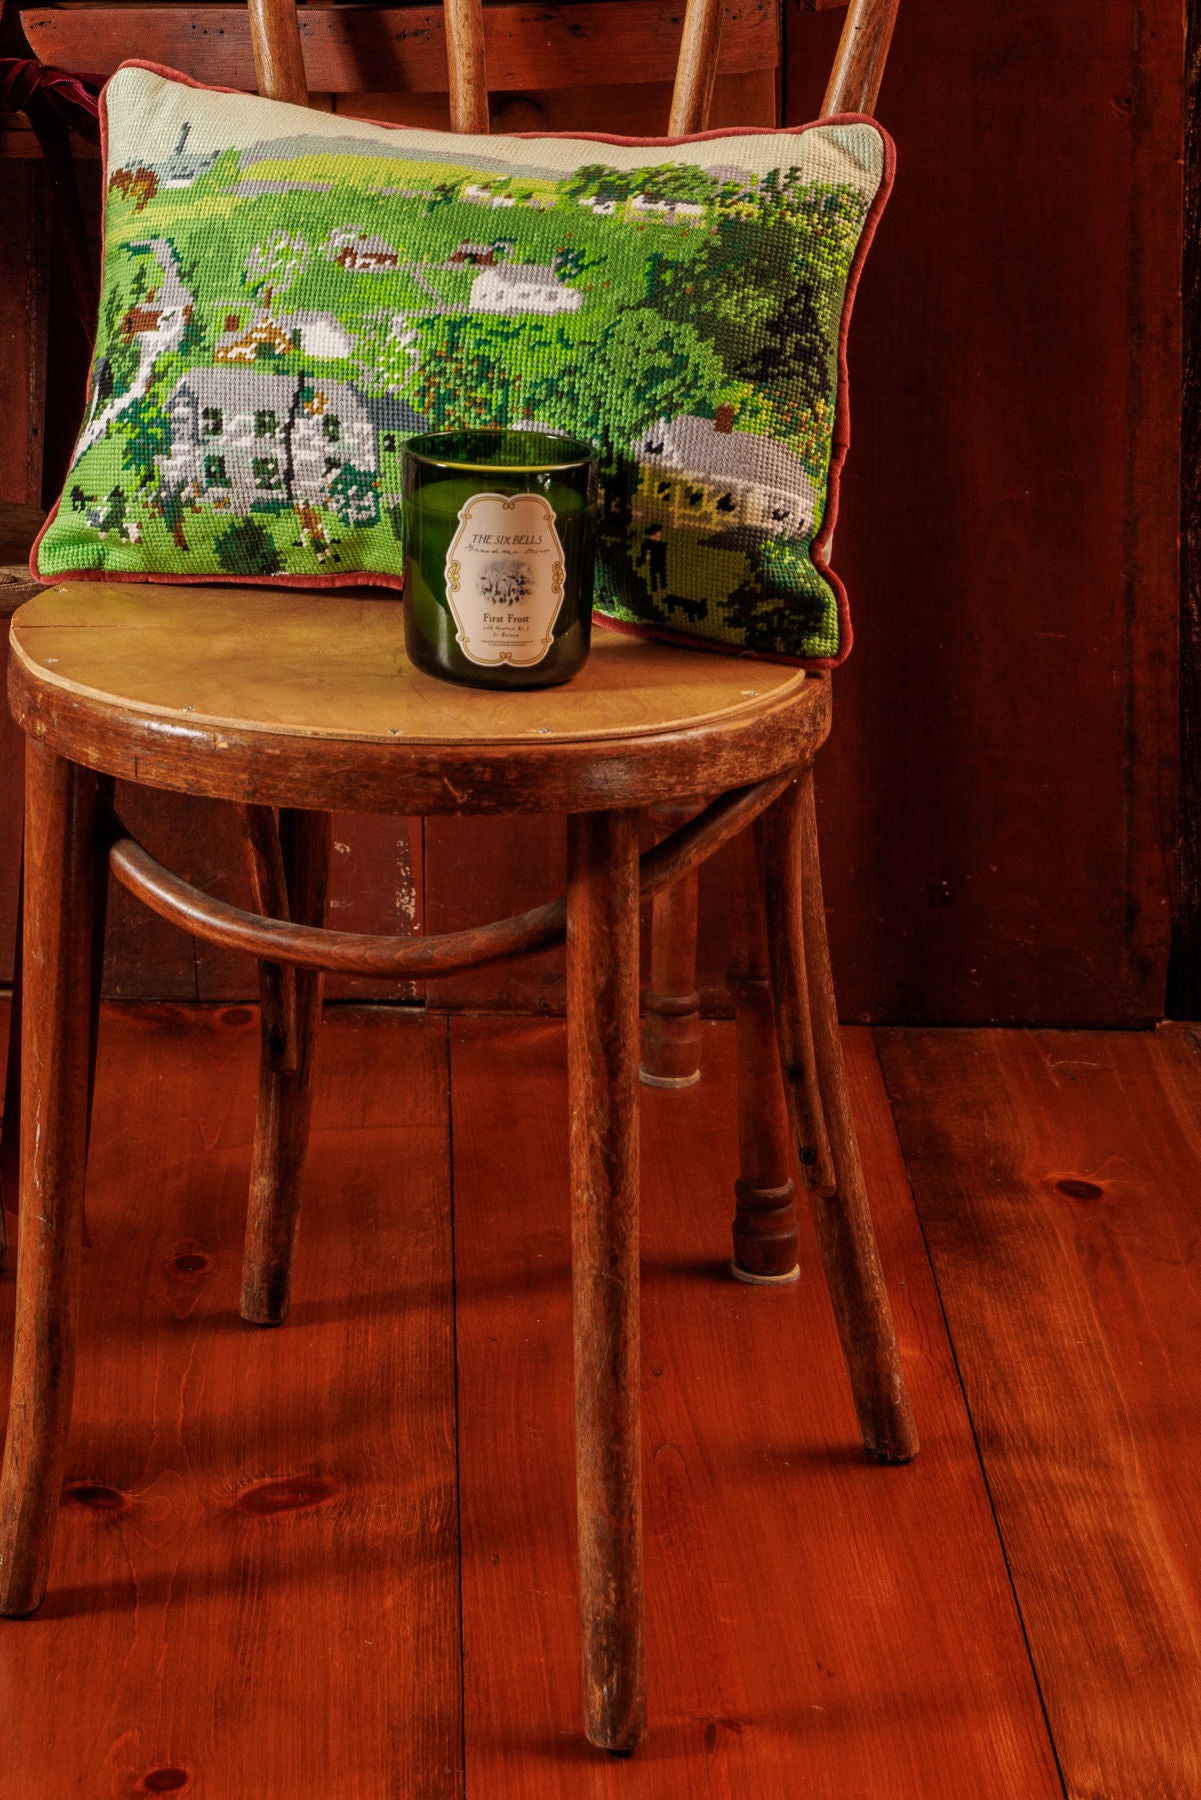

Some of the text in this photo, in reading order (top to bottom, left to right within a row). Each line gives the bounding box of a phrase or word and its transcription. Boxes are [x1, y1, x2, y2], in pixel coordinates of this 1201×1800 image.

[472, 533, 543, 545] THE SIX BELLS
[483, 613, 529, 623] First Frost
